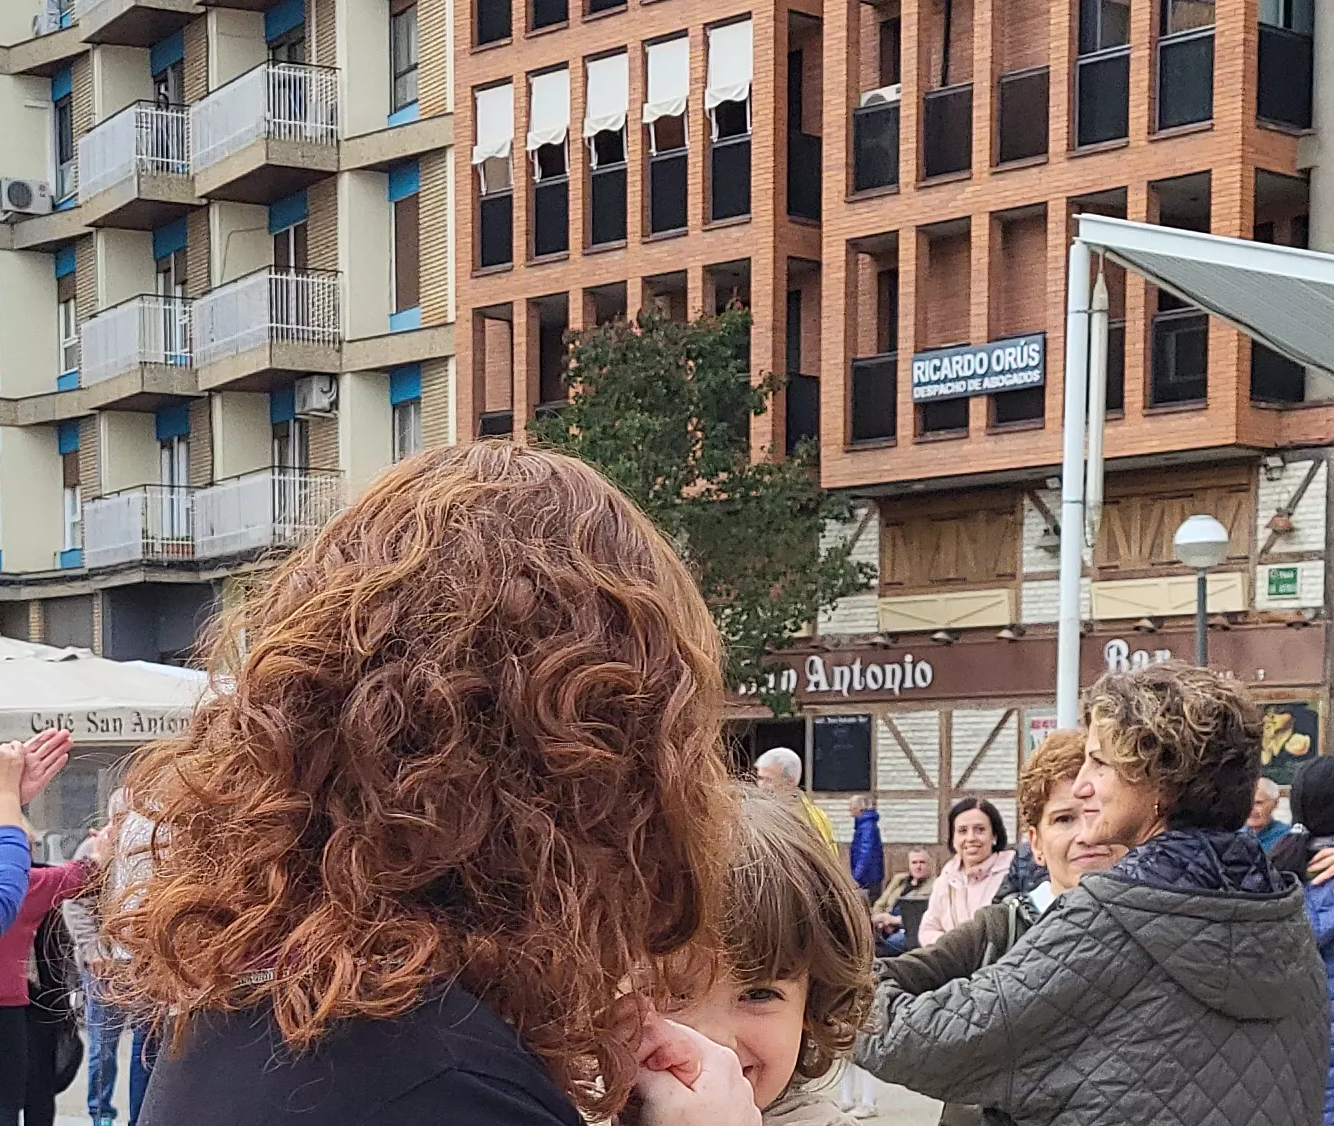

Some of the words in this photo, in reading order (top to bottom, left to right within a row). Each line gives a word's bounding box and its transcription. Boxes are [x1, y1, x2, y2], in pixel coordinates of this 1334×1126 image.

[913, 351, 988, 384] RICARDO
[990, 339, 1040, 372] ORÚS
[913, 380, 967, 399] DESPACHO
[968, 378, 982, 391] DE
[982, 369, 1041, 389] ABOGADOS
[804, 654, 933, 698] Antonio
[30, 711, 75, 734] Café
[86, 711, 123, 736] San
[130, 711, 190, 736] Anton
